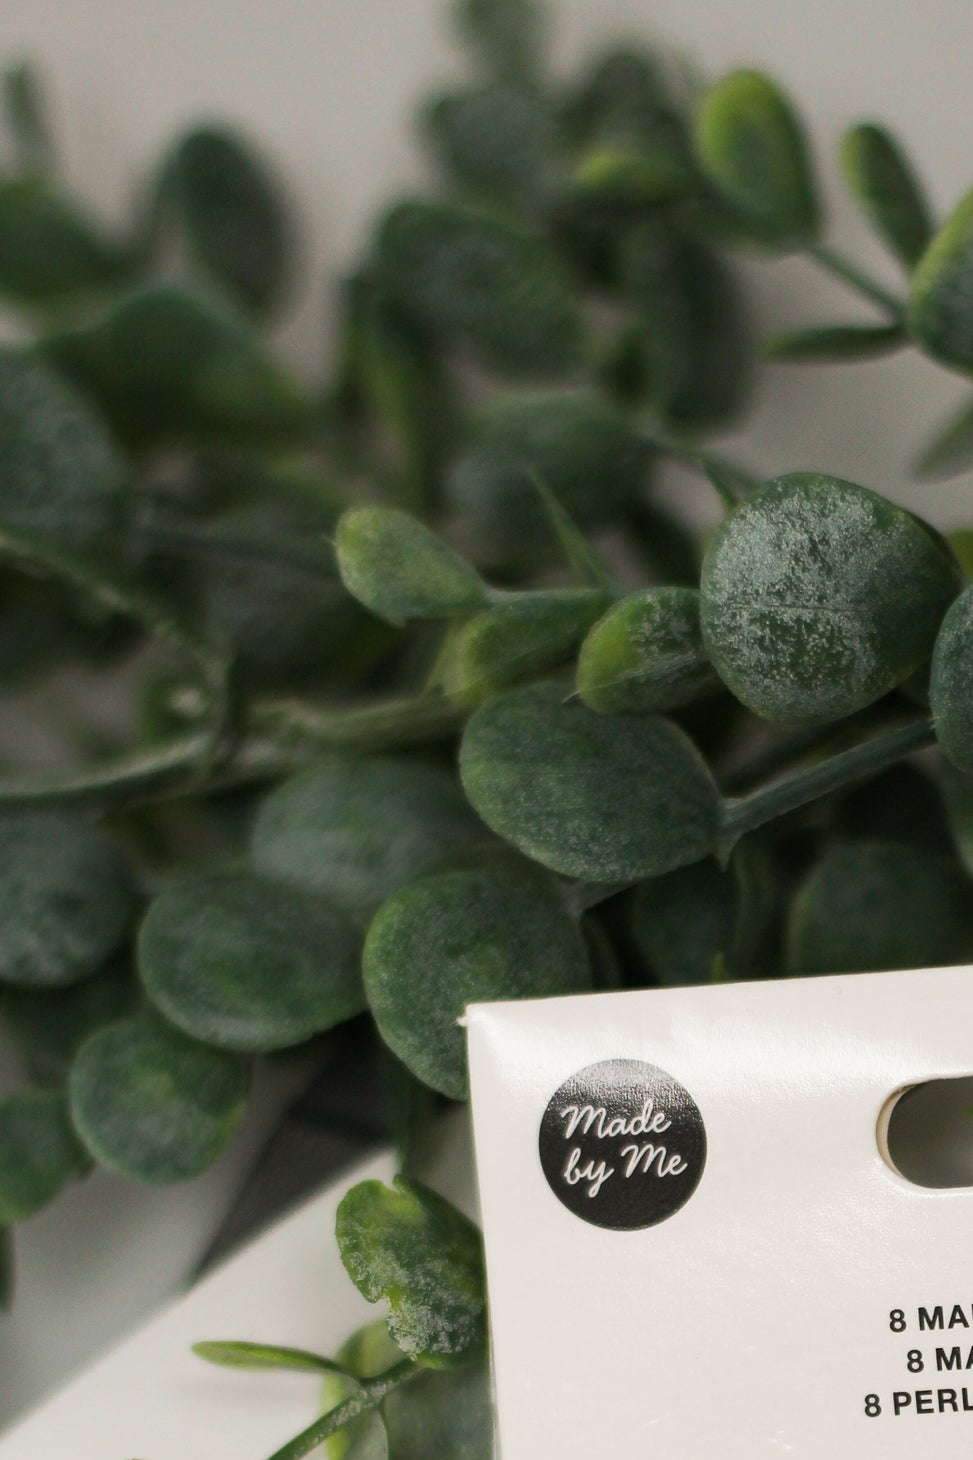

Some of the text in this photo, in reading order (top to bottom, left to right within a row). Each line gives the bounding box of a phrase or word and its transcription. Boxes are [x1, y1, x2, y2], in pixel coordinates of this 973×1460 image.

[560, 1098, 671, 1139] Made
[563, 1143, 687, 1198] by Me
[889, 1308, 907, 1333] 8
[906, 1349, 925, 1374] 8
[864, 1393, 882, 1418] 8
